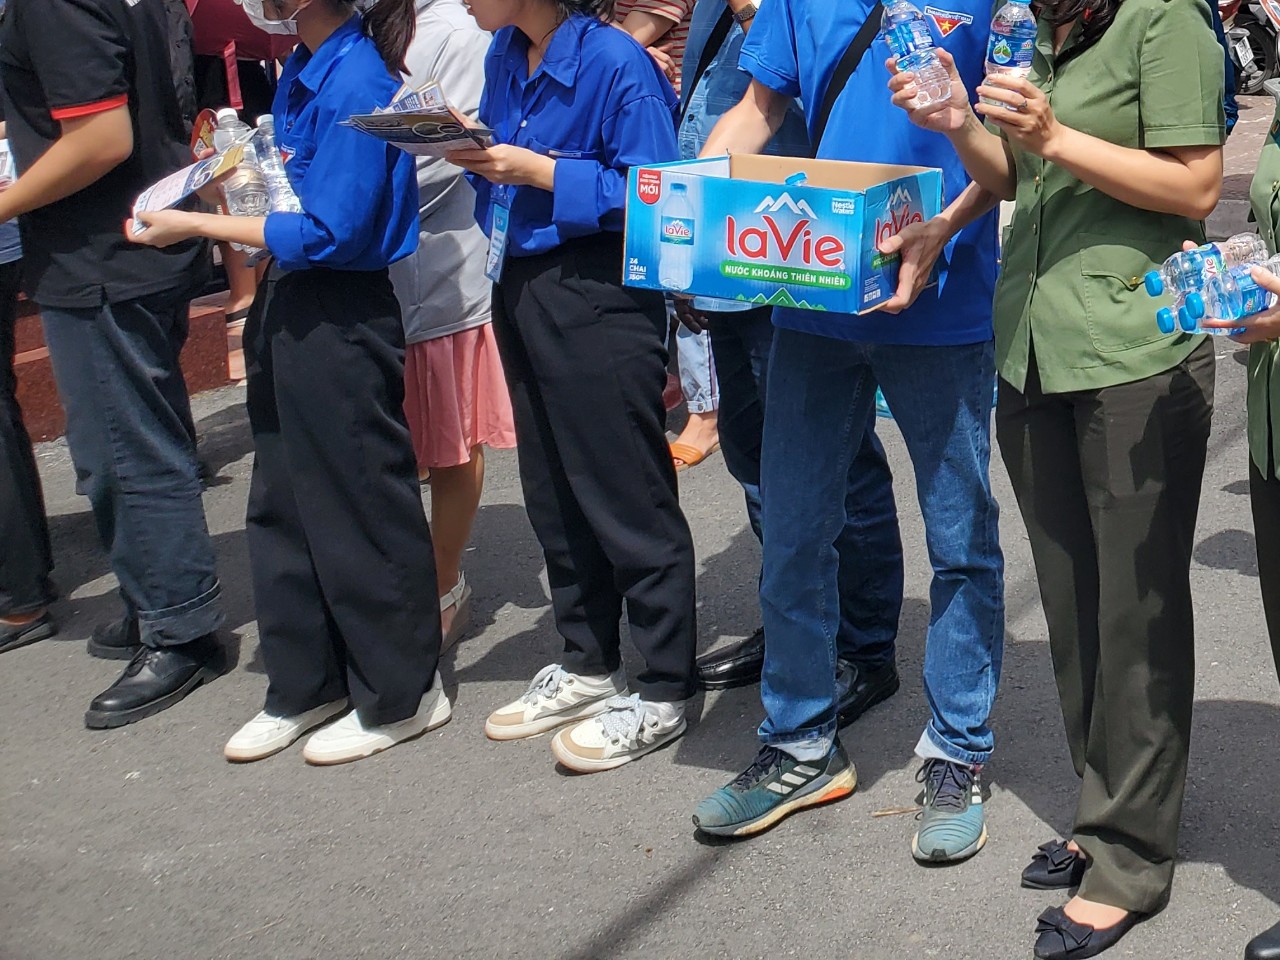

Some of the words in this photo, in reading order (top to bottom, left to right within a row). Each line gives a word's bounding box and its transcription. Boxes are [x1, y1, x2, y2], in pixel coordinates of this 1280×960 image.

[639, 183, 659, 195] MỚI
[664, 224, 690, 236] laVie
[725, 214, 846, 268] laVie
[629, 265, 647, 273] CHAI
[725, 264, 750, 276] NƯỚC
[752, 268, 789, 280] KHOÁNG
[791, 272, 817, 283] THIÊN
[819, 275, 846, 286] NHIÊN
